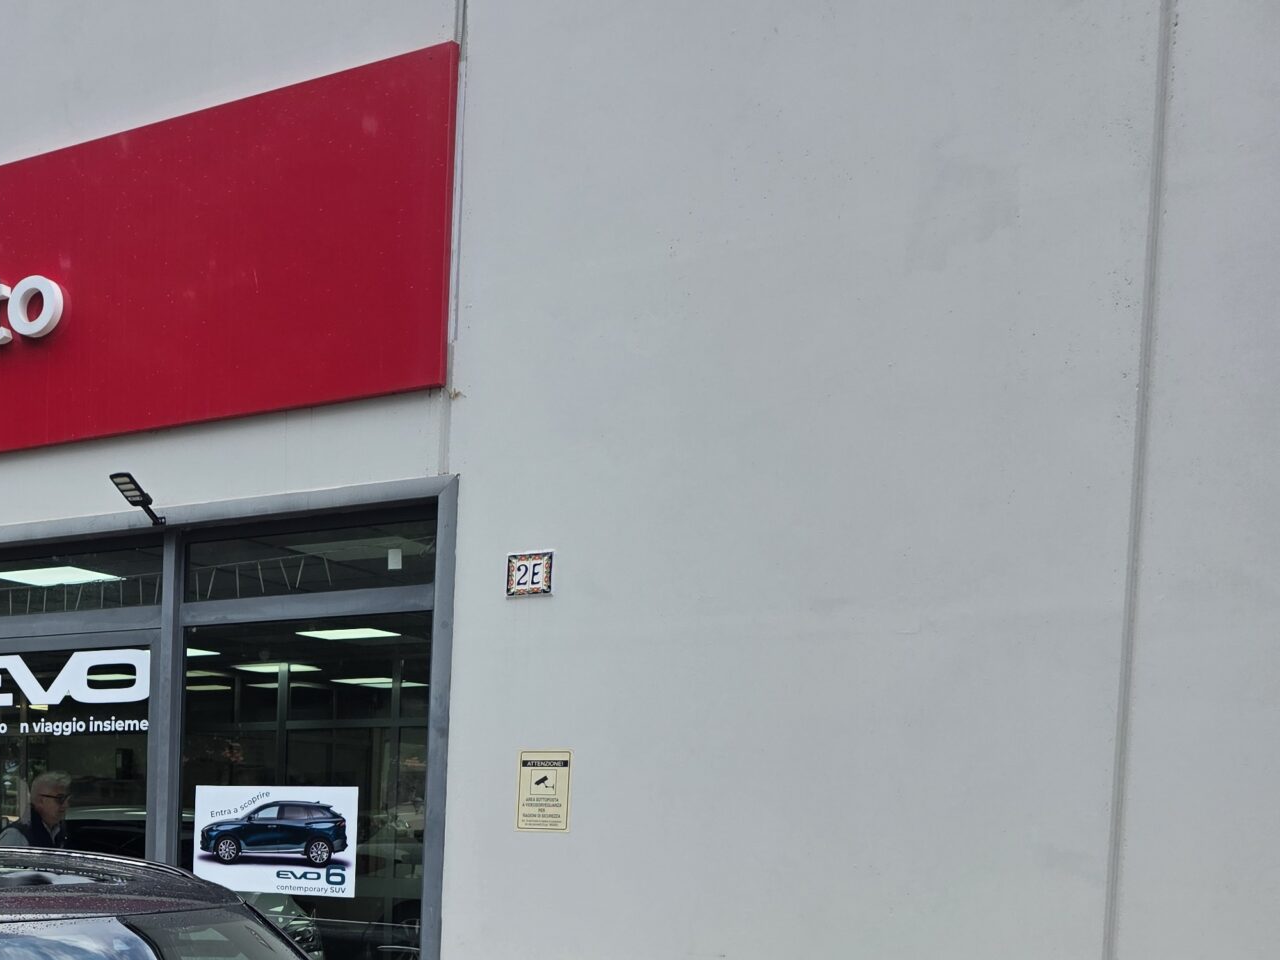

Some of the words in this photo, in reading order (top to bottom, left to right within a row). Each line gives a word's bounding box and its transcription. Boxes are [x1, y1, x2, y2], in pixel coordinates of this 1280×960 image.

[516, 562, 542, 586] 2E
[32, 717, 85, 736] viaggio
[88, 716, 149, 732] insieme
[210, 808, 232, 818] Entra
[239, 791, 271, 811] scoprire
[276, 870, 322, 880] EVO
[325, 865, 346, 886] 6
[276, 884, 328, 894] contemporary
[329, 886, 347, 894] SUV
